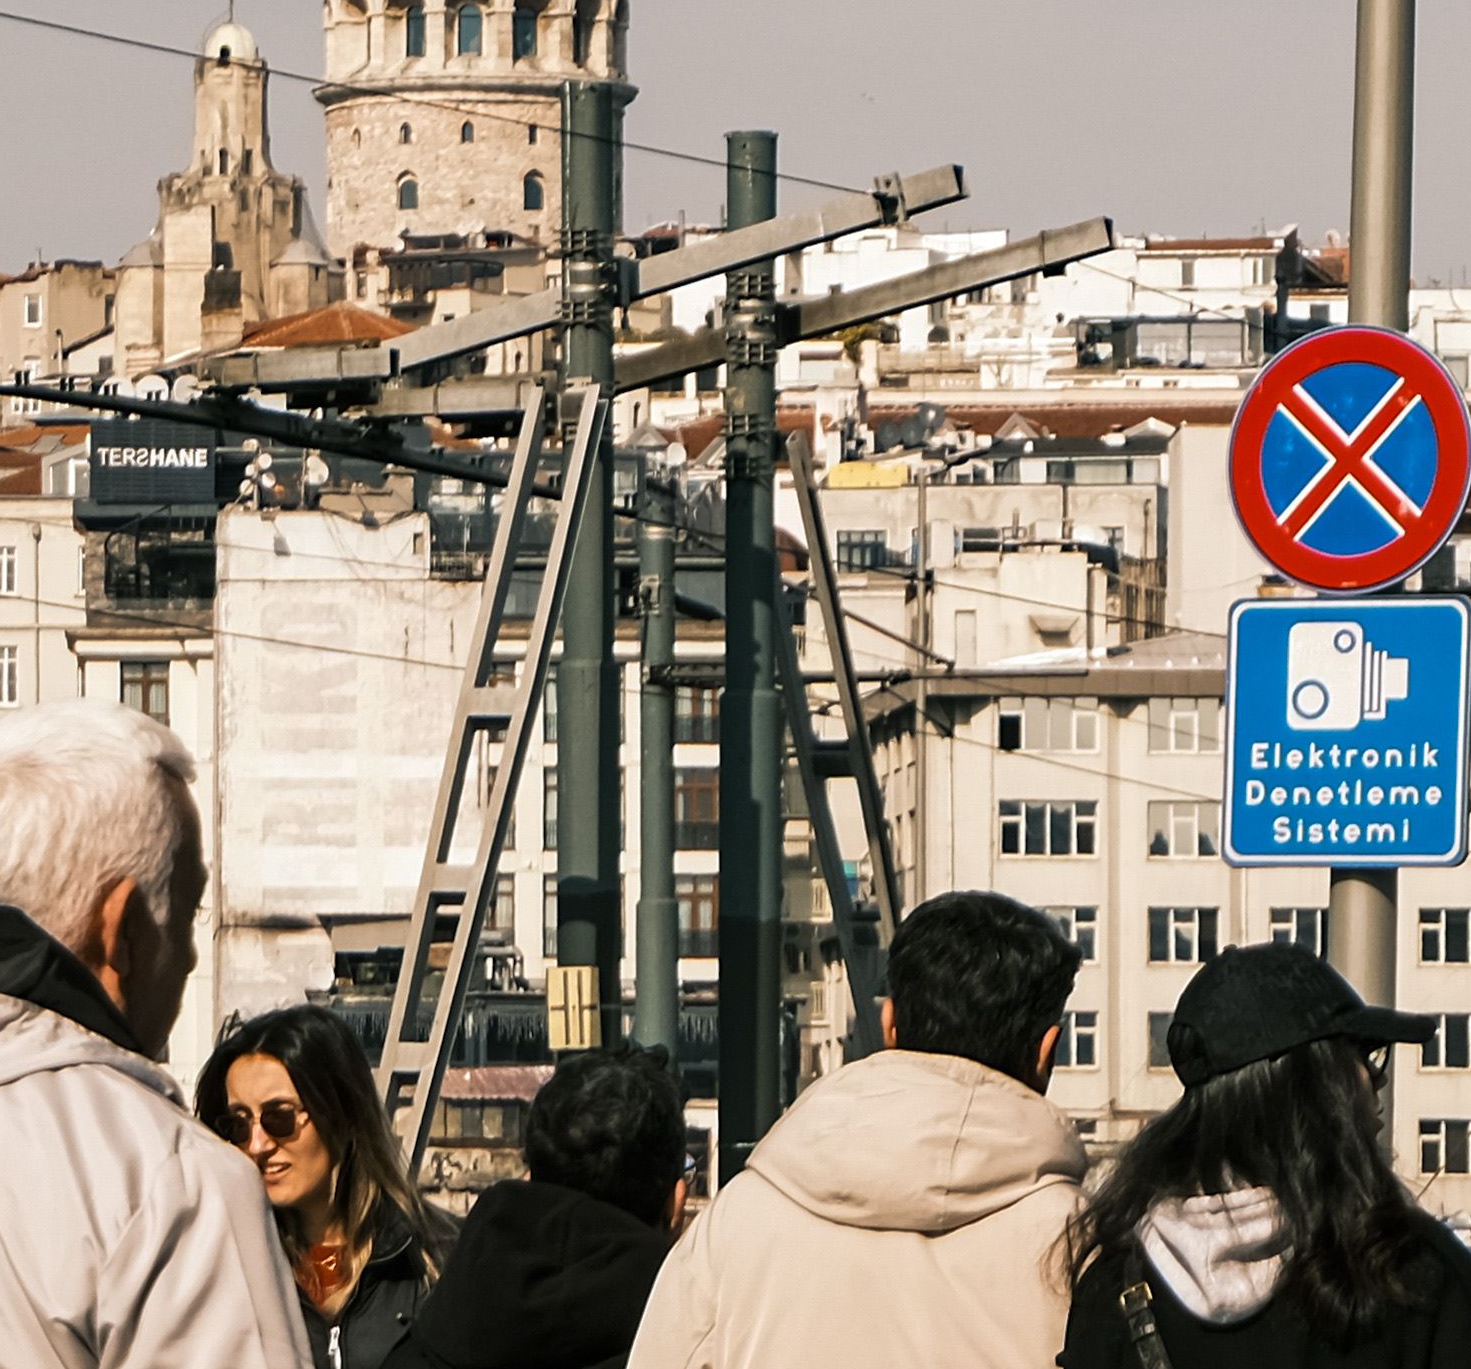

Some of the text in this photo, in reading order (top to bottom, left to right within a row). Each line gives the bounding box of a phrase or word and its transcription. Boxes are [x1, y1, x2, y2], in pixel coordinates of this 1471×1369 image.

[1250, 741, 1440, 770] Elektronik
[1244, 778, 1443, 806] Denetleme
[1272, 816, 1410, 845] Sistemi
